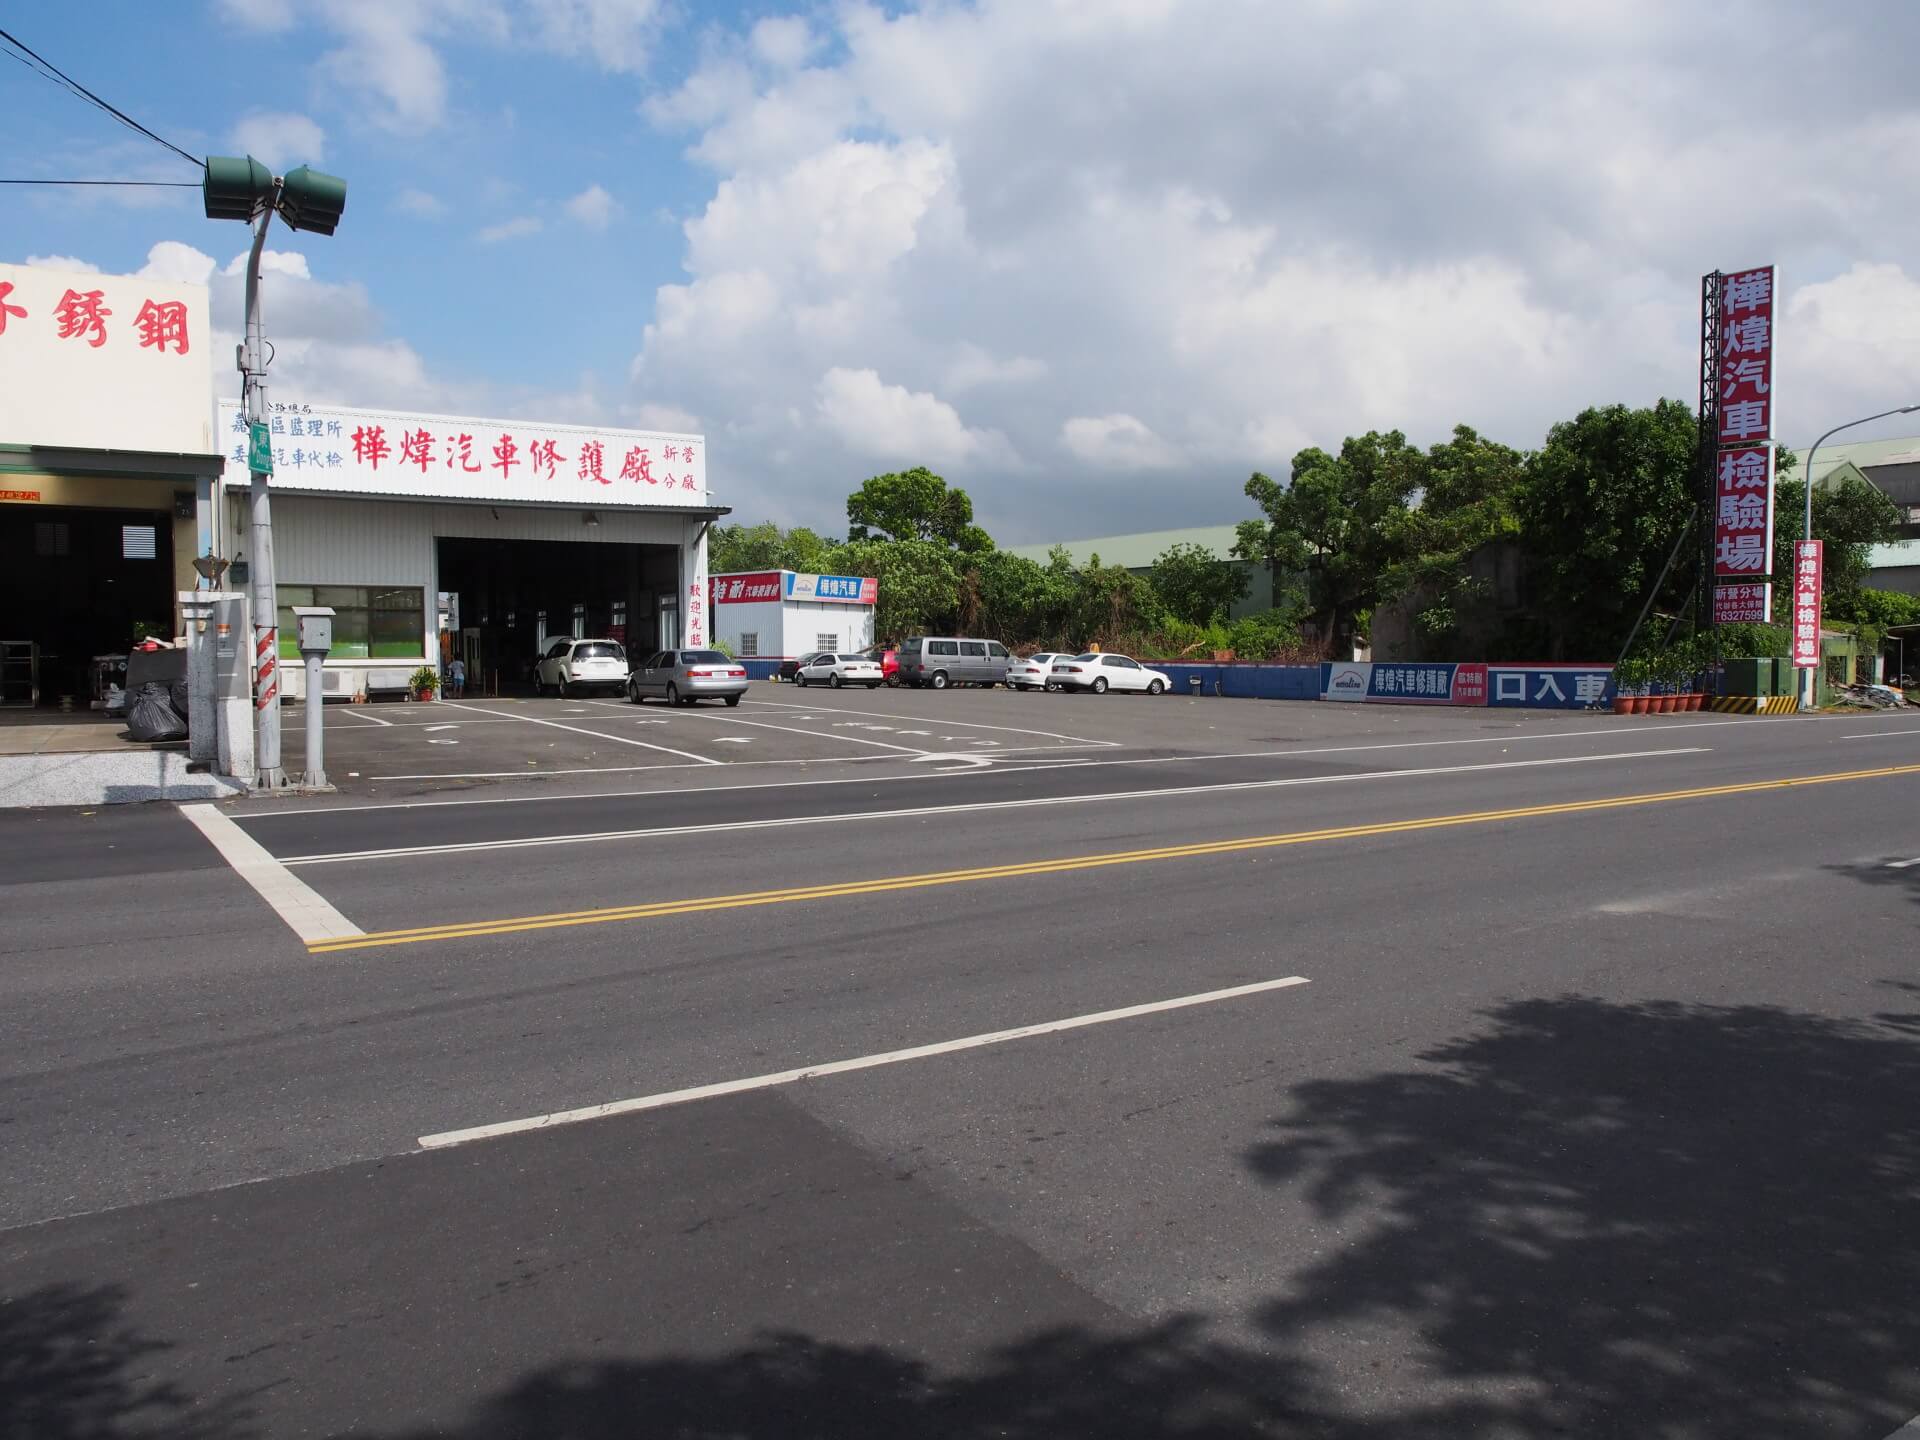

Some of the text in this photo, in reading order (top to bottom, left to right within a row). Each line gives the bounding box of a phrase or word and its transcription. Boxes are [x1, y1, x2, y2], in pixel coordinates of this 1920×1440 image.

[1723, 272, 1770, 439] 樺煒汽車
[232, 413, 343, 437] 嘉區監理所
[231, 445, 343, 469] 委汽車代檢
[351, 425, 658, 485] 樺煒汽車修護廠
[664, 473, 697, 491] 分廠
[1717, 451, 1766, 570] 檢驗場
[820, 579, 857, 596] 樺煒汽車
[1797, 543, 1817, 656] 樺煒汽車檢驗場
[690, 584, 702, 647] 歡迎光臨
[1720, 610, 1763, 621] 6327599
[1375, 668, 1448, 695] 樺煒汽車修護廠
